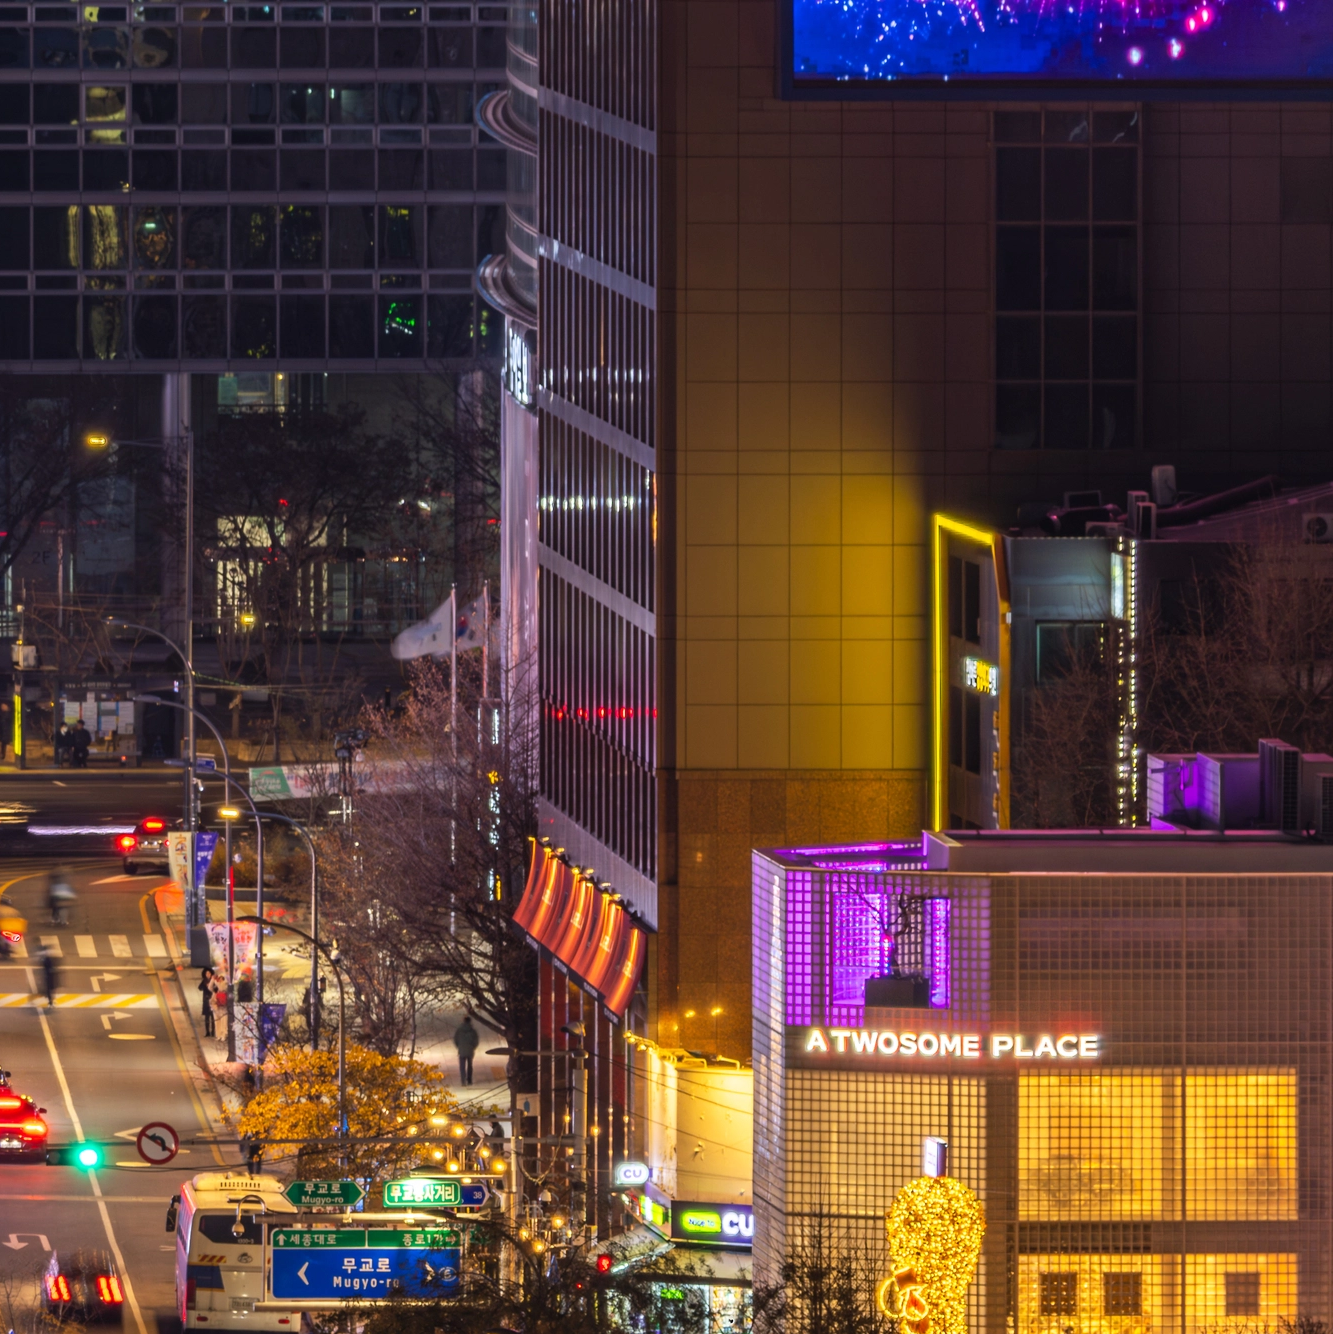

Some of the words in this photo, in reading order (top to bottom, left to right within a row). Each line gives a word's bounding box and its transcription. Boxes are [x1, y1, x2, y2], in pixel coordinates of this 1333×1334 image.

[806, 1029, 827, 1052] A
[831, 1030, 981, 1057] TWOSOME
[991, 1035, 1099, 1058] PLACE
[623, 1168, 643, 1179] CU
[303, 1183, 342, 1195] 무교로
[301, 1195, 344, 1205] Mugyo-ro
[472, 1191, 483, 1200] 38
[721, 1211, 755, 1237] CU
[289, 1233, 338, 1246] 세종대로
[341, 1257, 392, 1275] 무교로
